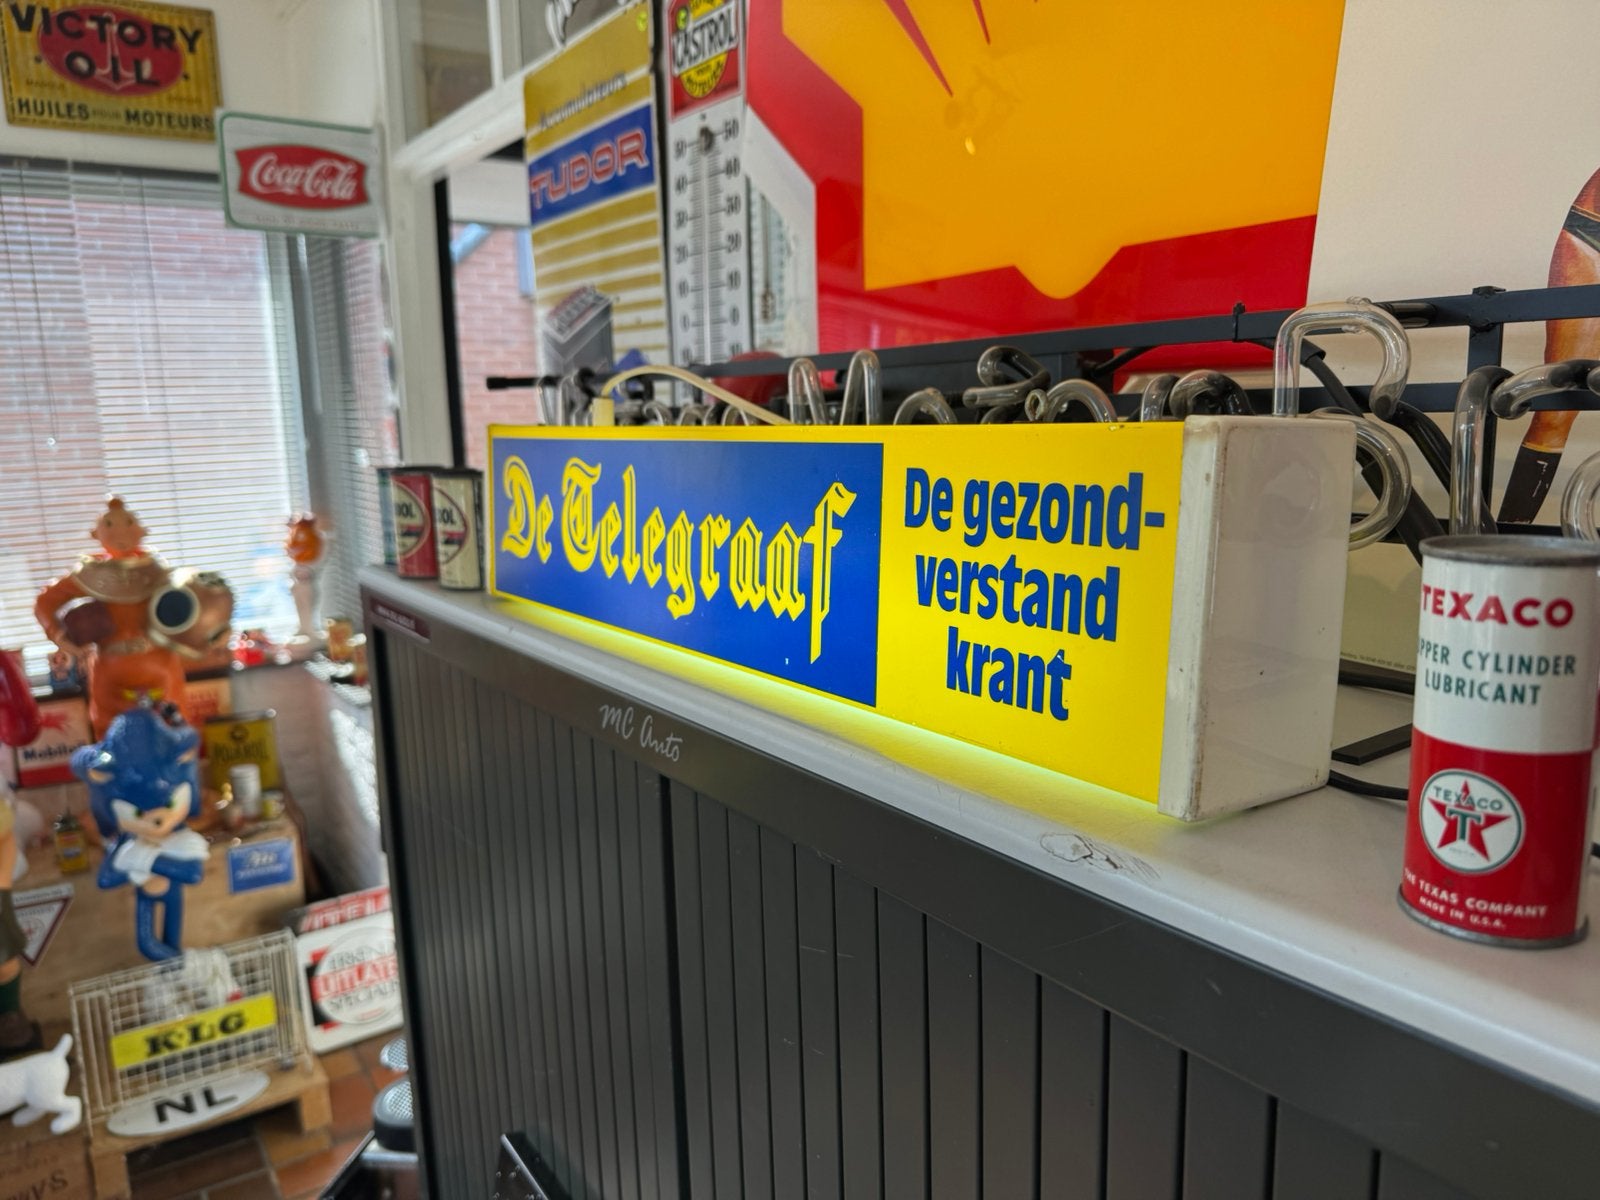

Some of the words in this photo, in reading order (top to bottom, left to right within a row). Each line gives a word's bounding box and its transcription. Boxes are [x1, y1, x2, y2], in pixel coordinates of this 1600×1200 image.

[10, 4, 201, 53] VICTORY
[673, 8, 736, 68] CASTROL
[65, 51, 160, 87] OIL
[18, 98, 90, 121] HUILES
[125, 109, 214, 131] MOTEURS
[530, 128, 648, 209] TUDOR
[904, 467, 953, 532] De
[963, 472, 1165, 551] gezond-
[501, 455, 554, 564] De
[561, 457, 857, 665] Telegraaf
[915, 554, 1120, 642] verstand
[1422, 583, 1574, 629] TEXACO
[946, 625, 1072, 722] krant
[1418, 636, 1450, 665] PPER
[1462, 649, 1577, 677] CYLINDER
[1425, 669, 1541, 706] LUBRICANT
[1433, 785, 1504, 812] TEXACO
[1448, 808, 1482, 842] T
[1419, 878, 1459, 904] TEXAS
[1465, 897, 1548, 918] COMPANY
[1419, 895, 1446, 914] MADE
[1450, 908, 1464, 921] IN
[1469, 914, 1507, 930] U.S.A.
[146, 1012, 247, 1058] KLG
[154, 1085, 239, 1124] NL
